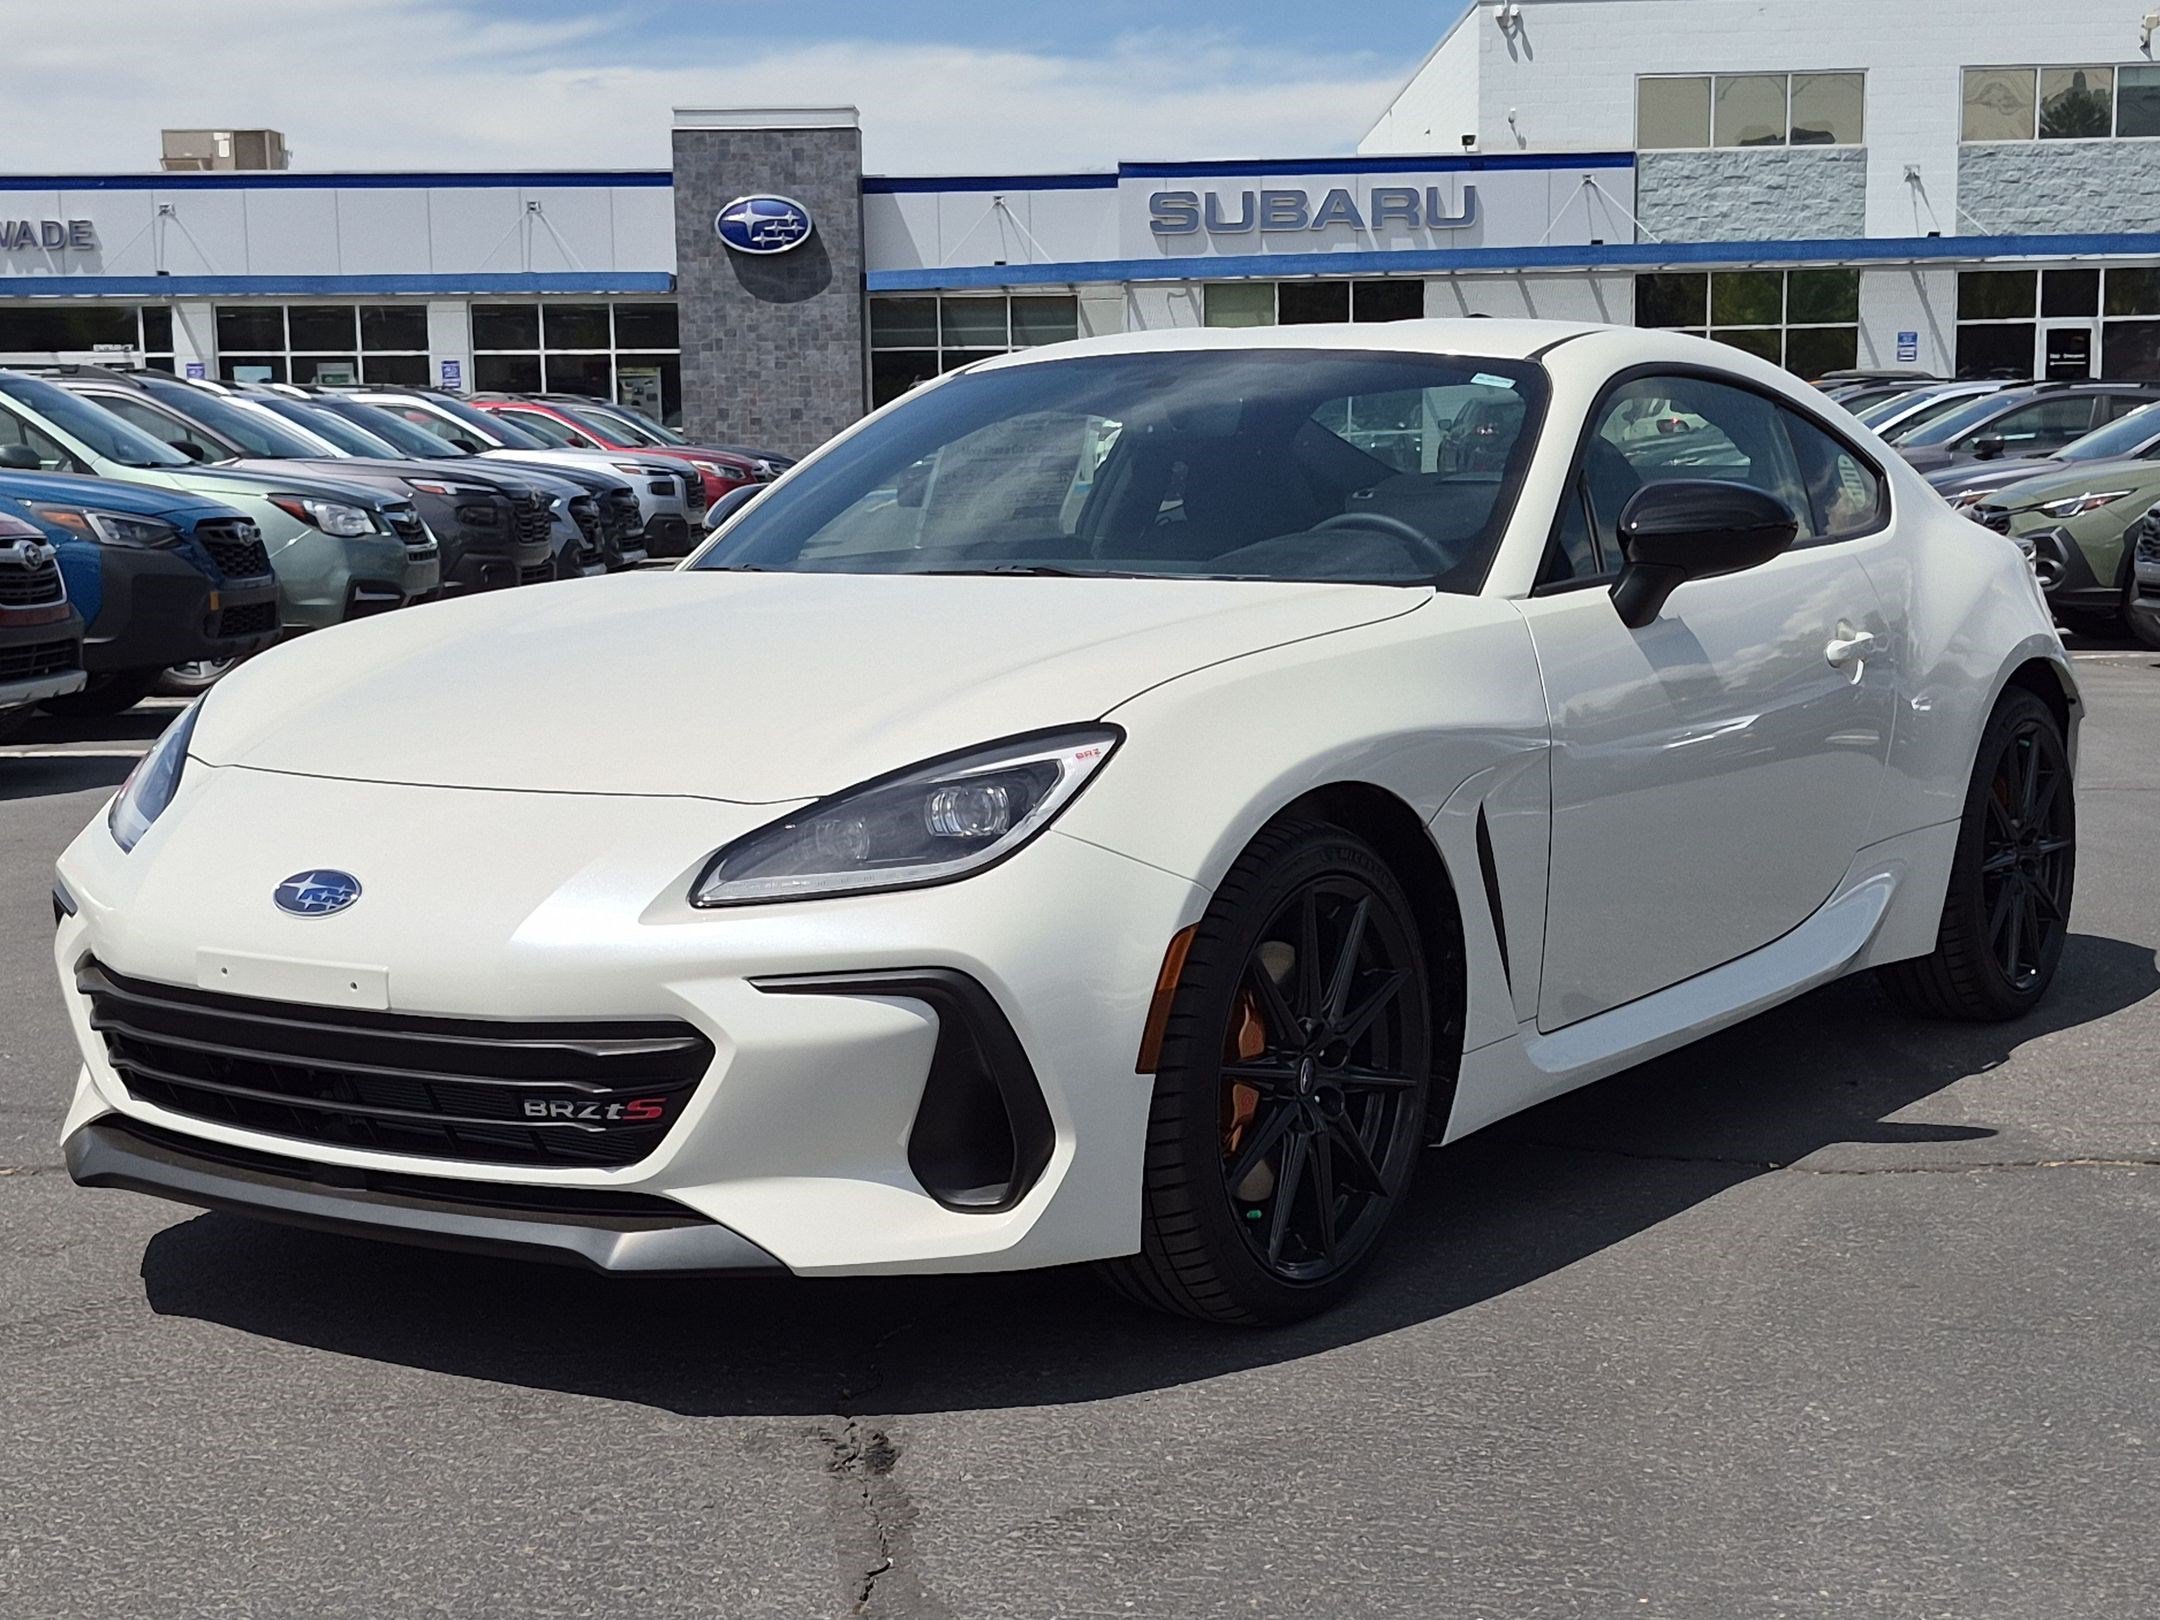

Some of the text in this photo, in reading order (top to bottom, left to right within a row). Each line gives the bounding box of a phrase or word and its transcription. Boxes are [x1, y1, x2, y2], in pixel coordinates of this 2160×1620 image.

[1150, 185, 1478, 235] SUBARU
[523, 1097, 667, 1120] BRZ tS
